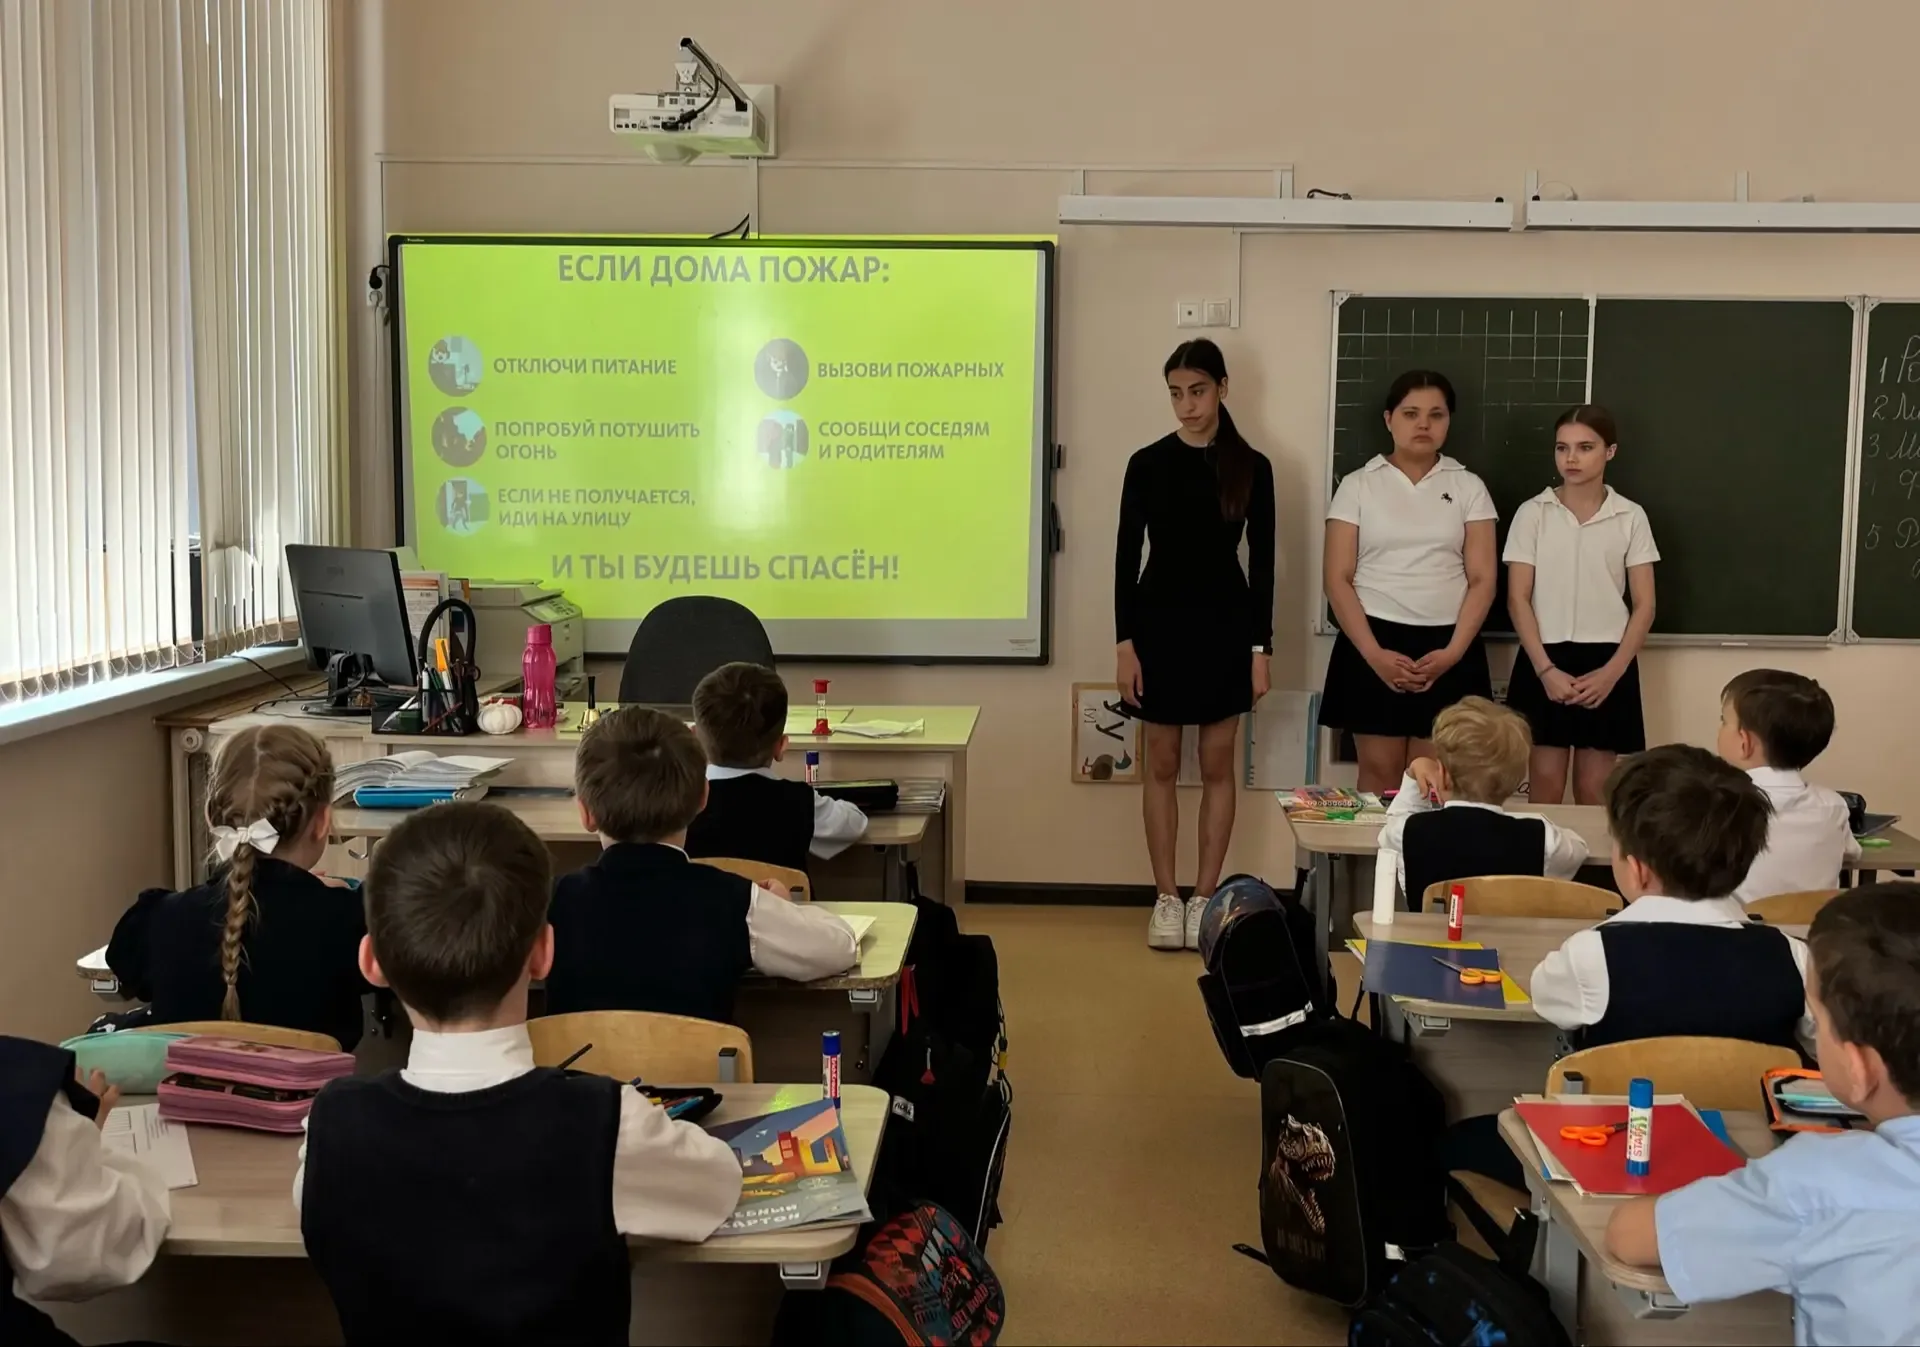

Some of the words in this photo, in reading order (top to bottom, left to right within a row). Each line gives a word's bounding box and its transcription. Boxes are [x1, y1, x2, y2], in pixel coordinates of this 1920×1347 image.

[558, 254, 641, 282] ЕСЛИ
[650, 255, 751, 287] ДОМА
[759, 255, 890, 283] ПОЖАР:
[493, 357, 587, 375] ОТКЛЮЧИ
[592, 358, 677, 375] ПИТАНИЕ
[817, 361, 892, 378] ВЫЗОВИ
[897, 361, 1004, 378] ПОЖАРНЫХ
[495, 419, 595, 438] ПОПРОБУЙ
[599, 422, 700, 439] ПОТУШИТЬ
[818, 421, 900, 439] СООБЩИ
[905, 421, 990, 439] СОСЕДЯМ
[496, 444, 557, 460] ОГОНЬ
[819, 444, 831, 459] И
[836, 444, 944, 461] РОДИТЕЛЯМ
[499, 488, 544, 504] ЕСЛИ
[549, 488, 571, 504] НЕ
[576, 488, 696, 506] ПОЛУЧАЕТСЯ,
[500, 511, 537, 528] ИДИ
[543, 511, 568, 526] НА
[572, 511, 631, 529] УЛИЦУ
[551, 554, 573, 580] И
[579, 554, 624, 580] ТЫ
[634, 554, 761, 585] БУДЕШЬ
[767, 549, 899, 580] СПАСЁН!
